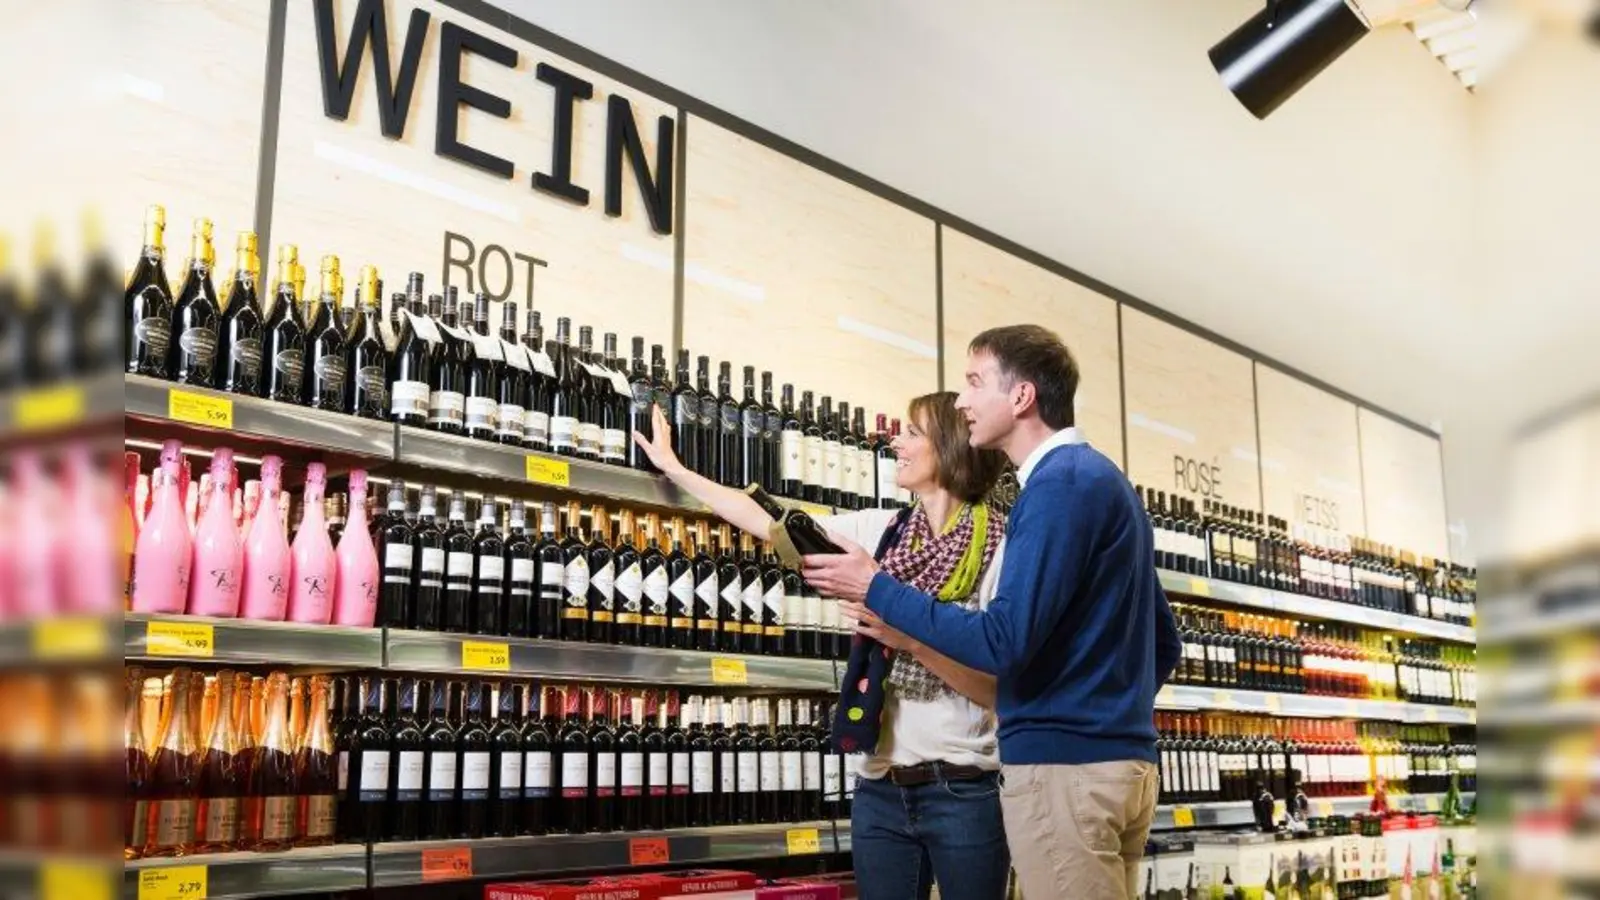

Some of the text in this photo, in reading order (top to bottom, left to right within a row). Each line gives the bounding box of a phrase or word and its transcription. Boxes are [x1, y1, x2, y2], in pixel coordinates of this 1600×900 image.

[313, 0, 674, 235] WEIN
[442, 230, 548, 310] ROT
[1174, 455, 1223, 499] ROSÉ
